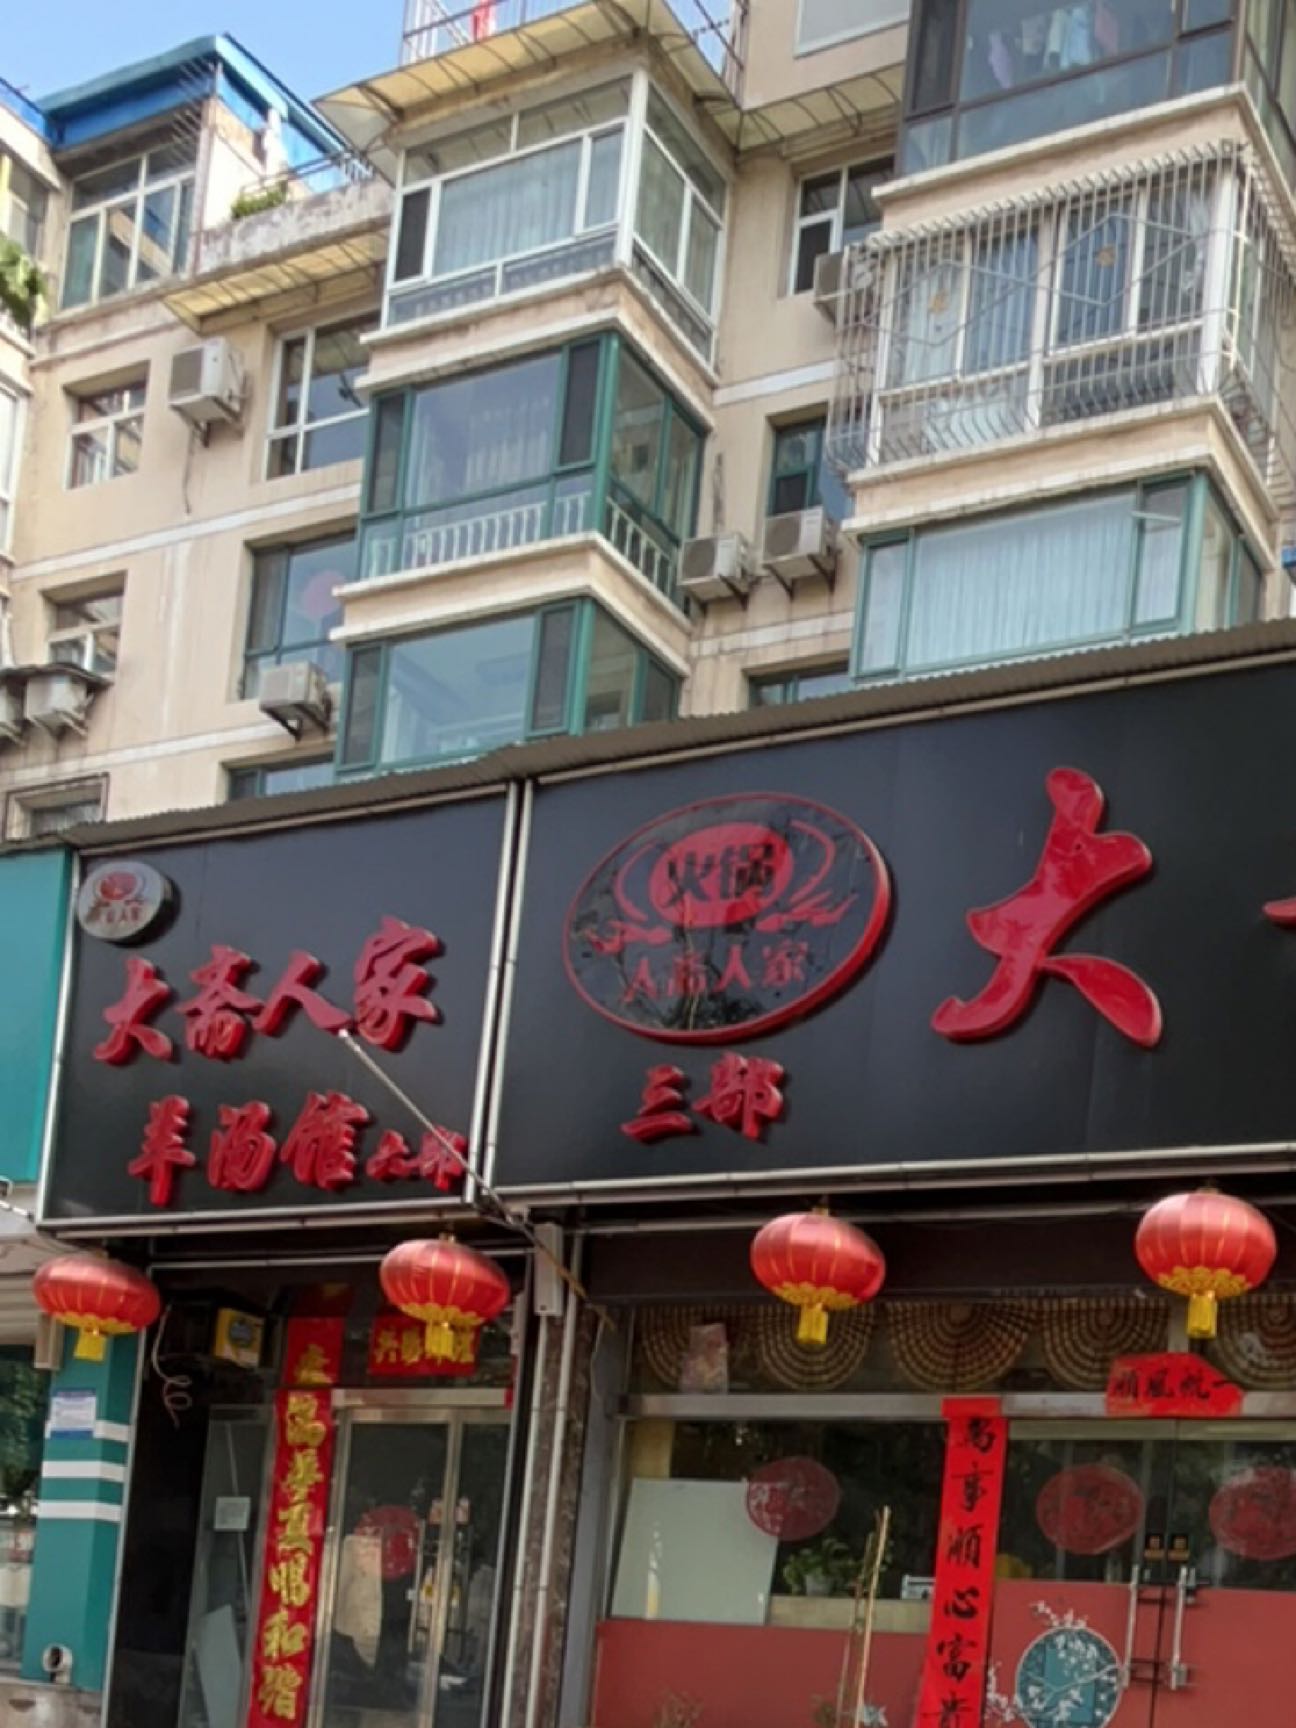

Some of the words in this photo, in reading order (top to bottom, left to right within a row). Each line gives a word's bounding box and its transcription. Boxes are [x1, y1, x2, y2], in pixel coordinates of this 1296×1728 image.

[93, 914, 442, 1065] 大斋人家
[620, 1050, 786, 1143] 三部
